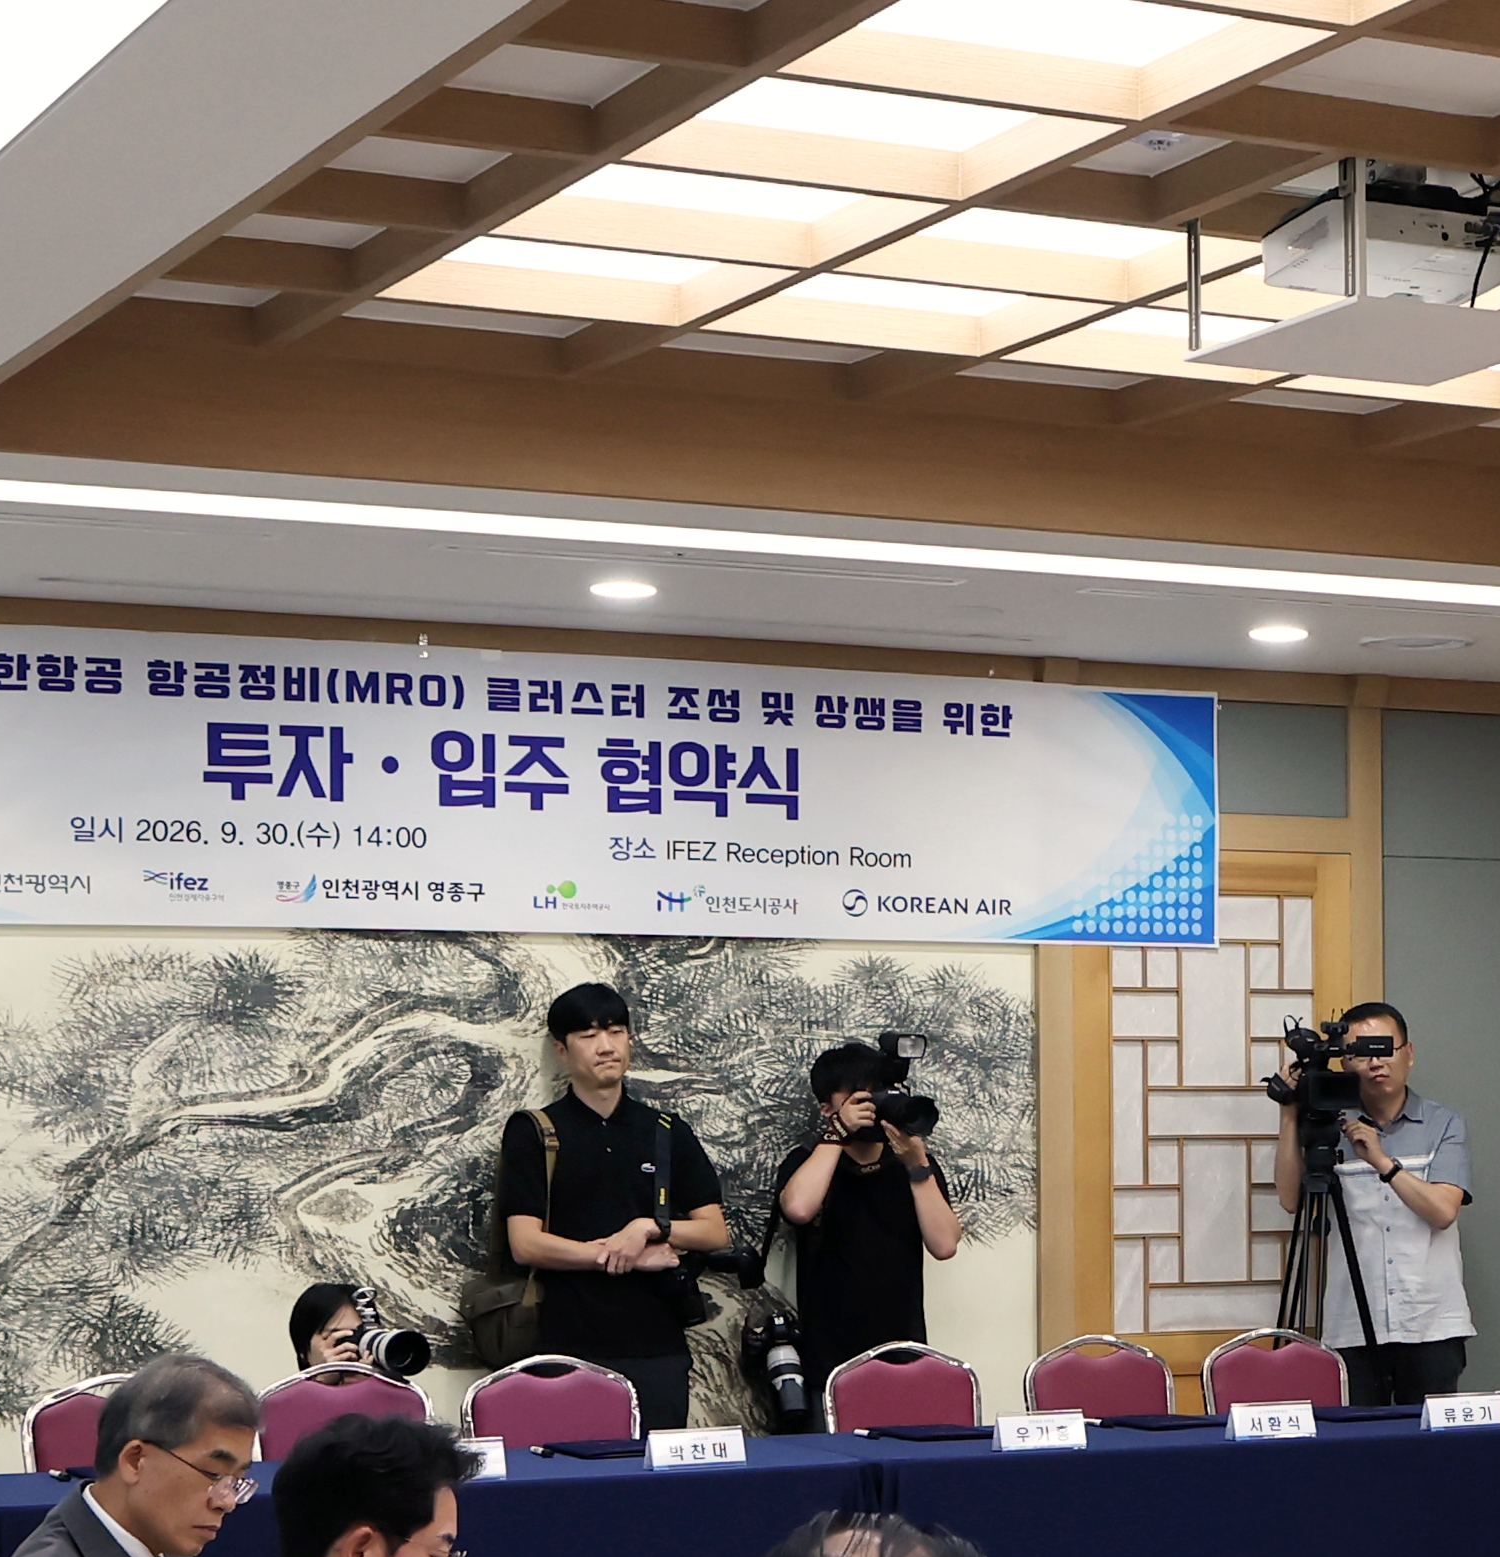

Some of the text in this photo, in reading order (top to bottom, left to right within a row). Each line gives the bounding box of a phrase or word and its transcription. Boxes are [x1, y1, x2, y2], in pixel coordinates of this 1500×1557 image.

[146, 659, 465, 710] 항공정비(MRO)
[486, 676, 645, 719] 클러스터
[667, 686, 740, 724] 조성
[761, 691, 794, 727] 및
[814, 694, 923, 733] 상생을
[942, 702, 1013, 738] 위한
[202, 721, 354, 803] 투자
[430, 730, 570, 811] 입주
[597, 737, 799, 821] 협약식
[70, 816, 123, 844] 일시
[136, 818, 209, 845] 2026.
[221, 821, 244, 846] 9.
[353, 825, 427, 849] 14:00
[609, 836, 912, 868] 장소 IFEZ Reception Room
[169, 872, 209, 891] ifez
[321, 878, 486, 903] 인천광역시 영종구
[533, 895, 557, 910] LH
[705, 896, 798, 915] 인천도시공사
[877, 895, 1012, 916] KOREAN AIR
[1250, 1415, 1301, 1432] 서환식
[1444, 1405, 1492, 1423] 류윤기
[1016, 1425, 1070, 1443] 우기홍
[669, 1442, 728, 1461] 박찬대
